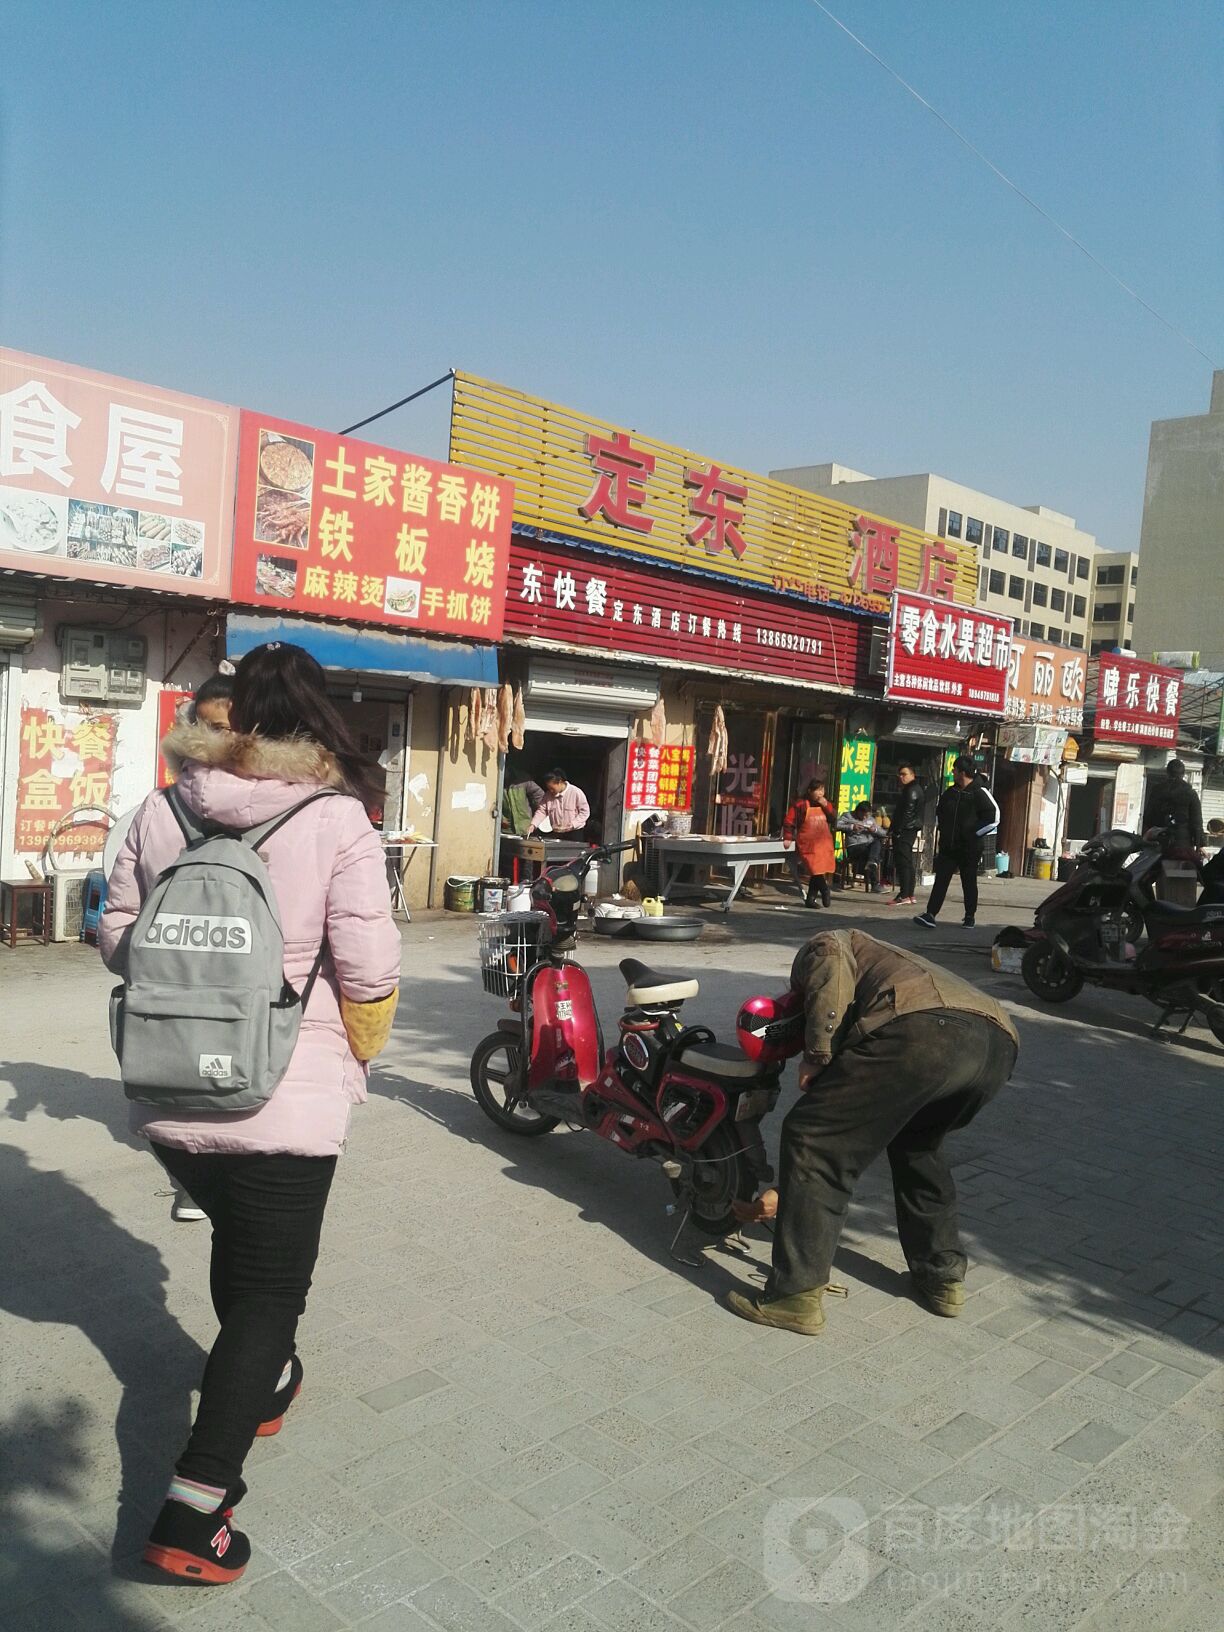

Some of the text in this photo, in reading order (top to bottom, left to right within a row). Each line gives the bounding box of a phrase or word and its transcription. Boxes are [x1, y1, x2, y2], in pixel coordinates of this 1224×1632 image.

[321, 446, 500, 532] 土家酱香饼
[318, 507, 495, 588] 铁板烧
[304, 567, 384, 609] 麻辣烫
[421, 588, 492, 625] 手抓饼
[504, 562, 608, 617] 东快餐
[612, 599, 742, 643] 定东酒店订餐热线
[756, 627, 823, 655] 13866920791
[900, 605, 1012, 670] 零食水果超市
[22, 716, 111, 762] 快餐
[840, 740, 871, 774] 水果
[20, 768, 109, 810] 盒饭
[145, 918, 246, 949] adidas
[202, 1067, 228, 1077] adidas
